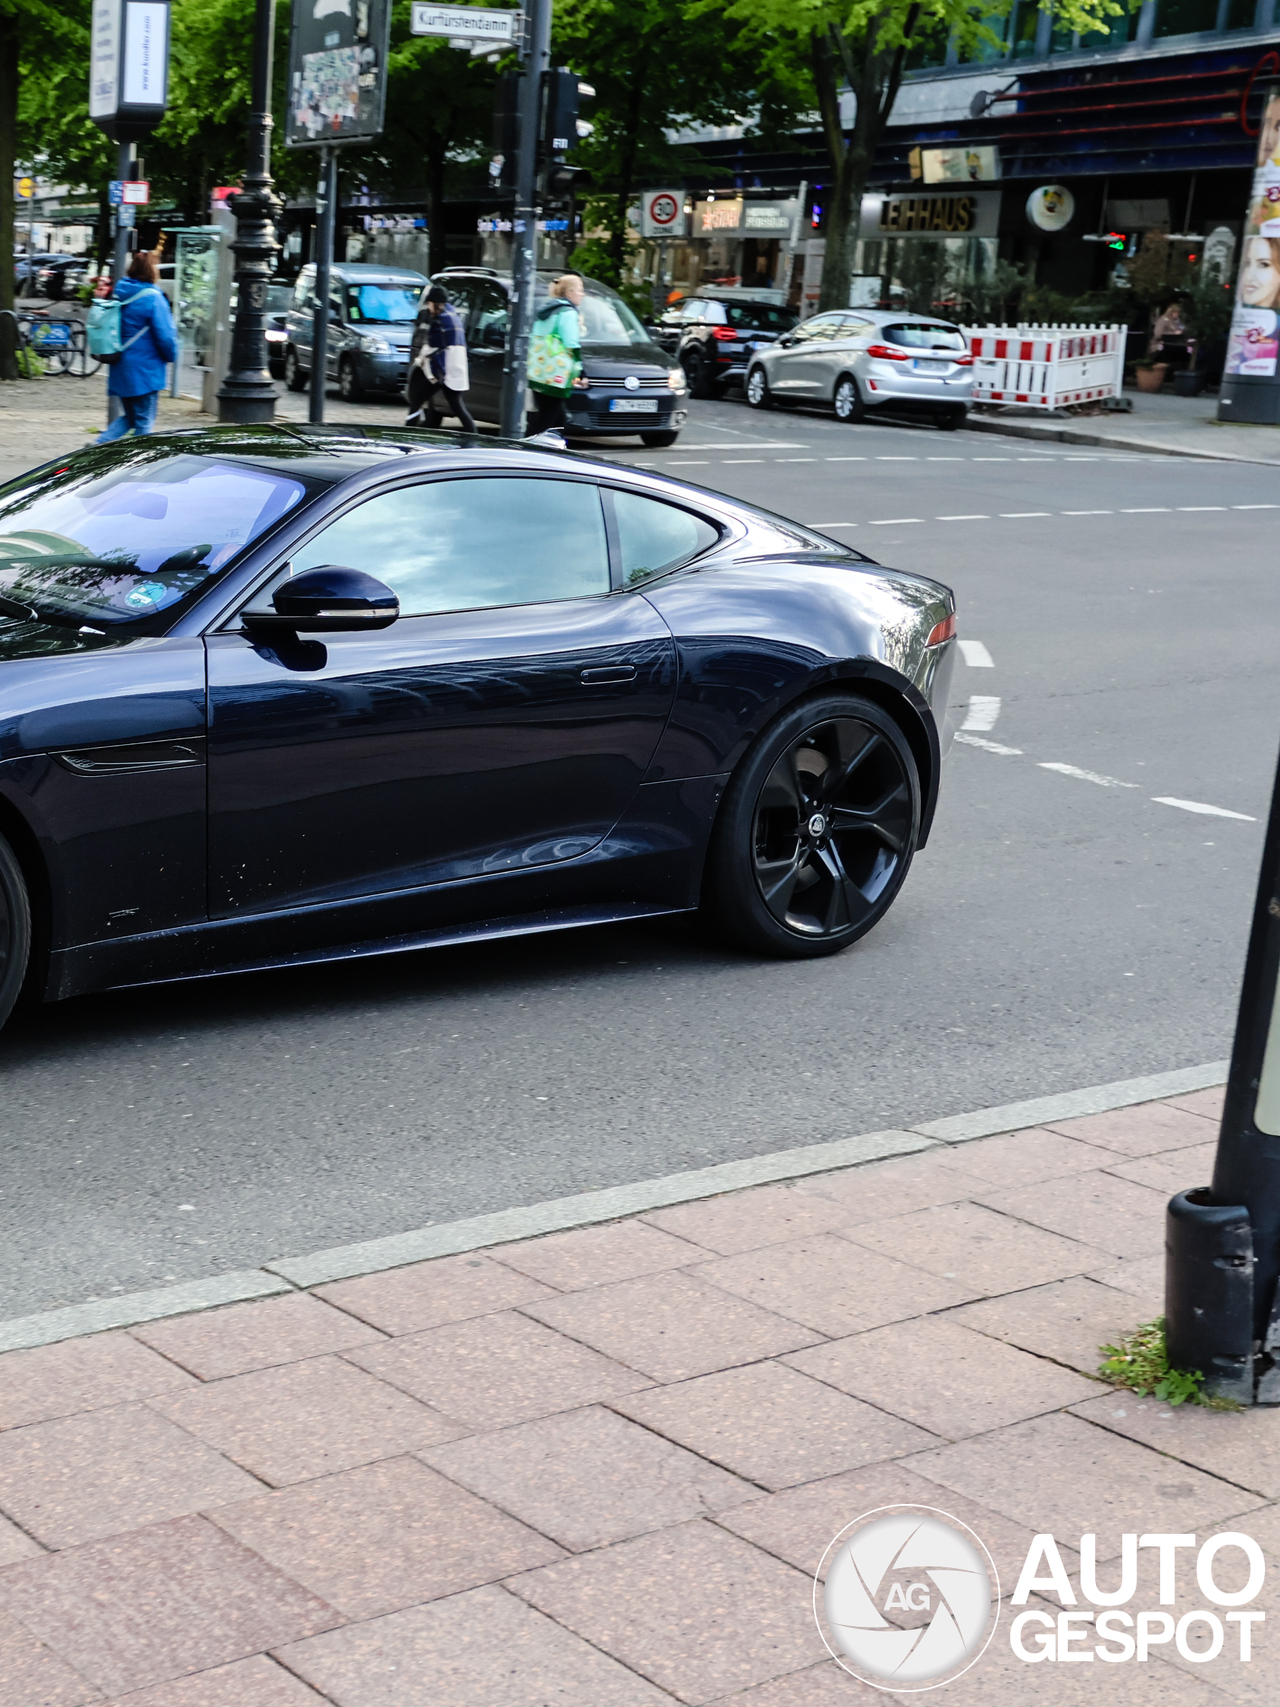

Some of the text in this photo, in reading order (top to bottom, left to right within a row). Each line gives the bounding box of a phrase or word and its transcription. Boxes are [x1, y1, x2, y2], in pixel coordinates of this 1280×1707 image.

[418, 10, 508, 31] Kurfürstendamm
[656, 202, 674, 217] 30
[880, 197, 976, 232] LEIHHAUS
